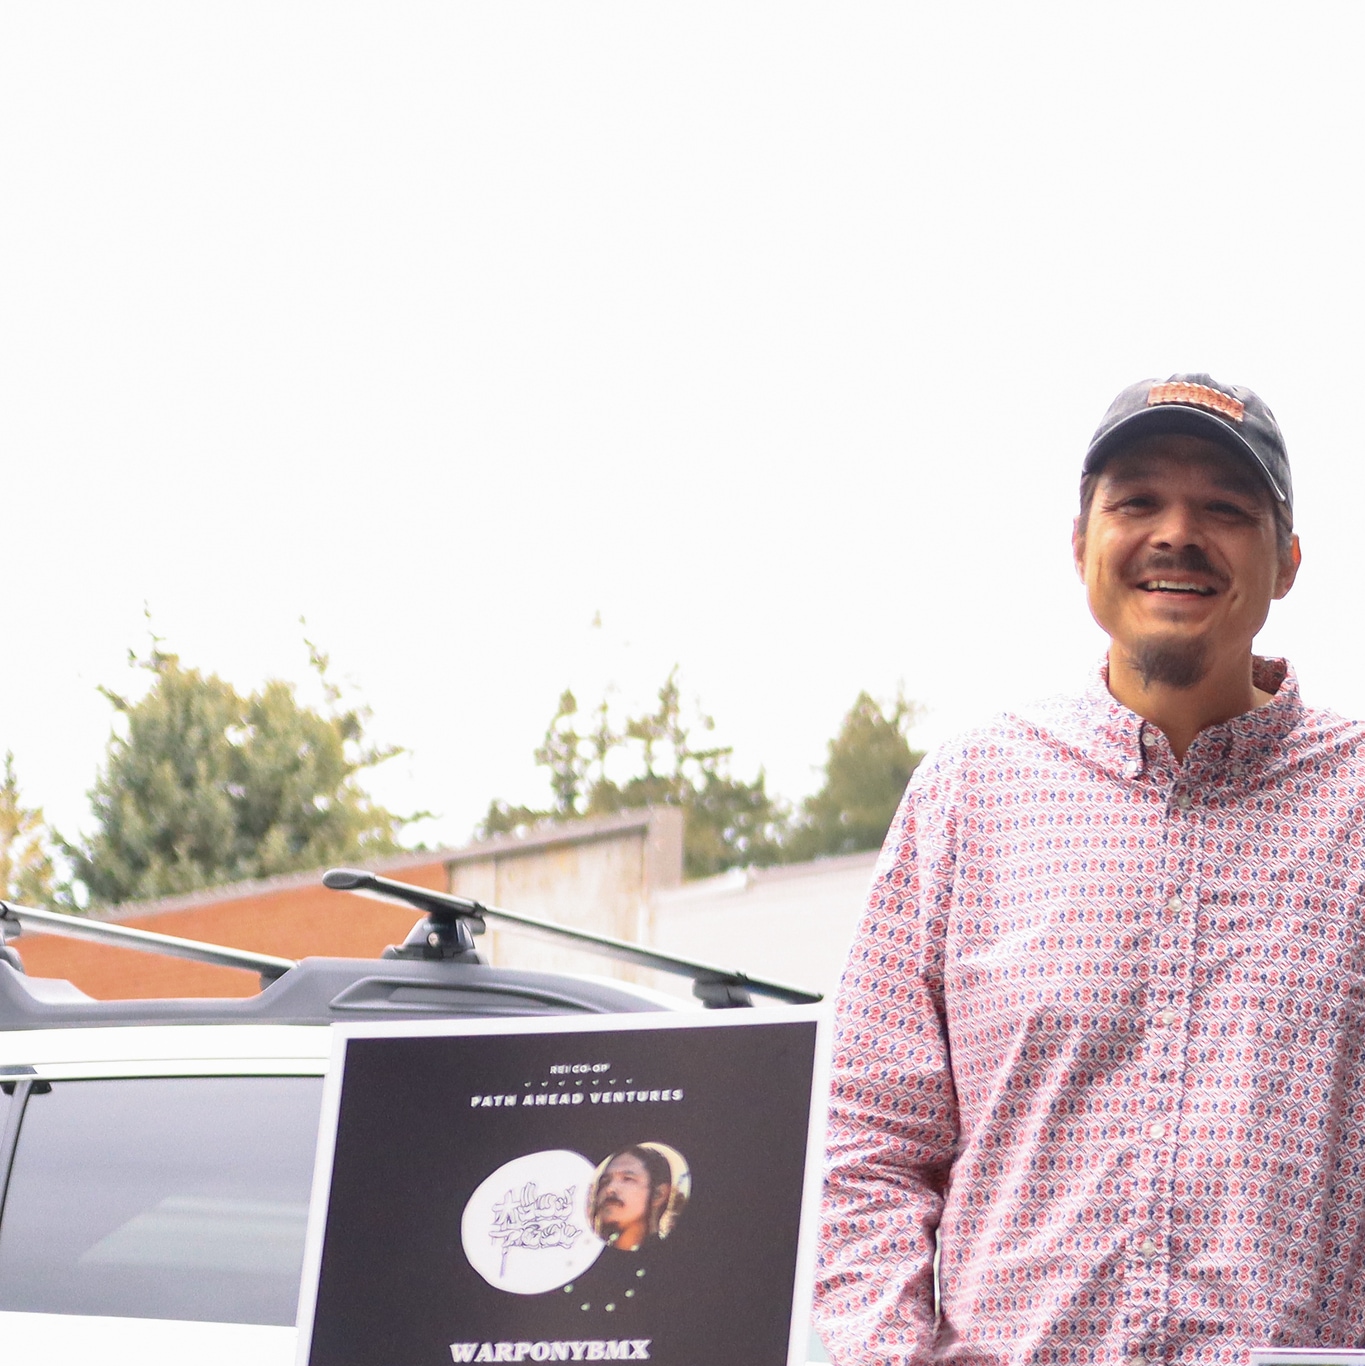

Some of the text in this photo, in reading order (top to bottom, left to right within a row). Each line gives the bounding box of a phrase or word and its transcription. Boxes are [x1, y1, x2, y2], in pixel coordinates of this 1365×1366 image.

[550, 1063, 611, 1075] REI CO-OP
[470, 1088, 684, 1107] PATH AHEAD VENTURES
[449, 1339, 652, 1363] WARPONYBMX
